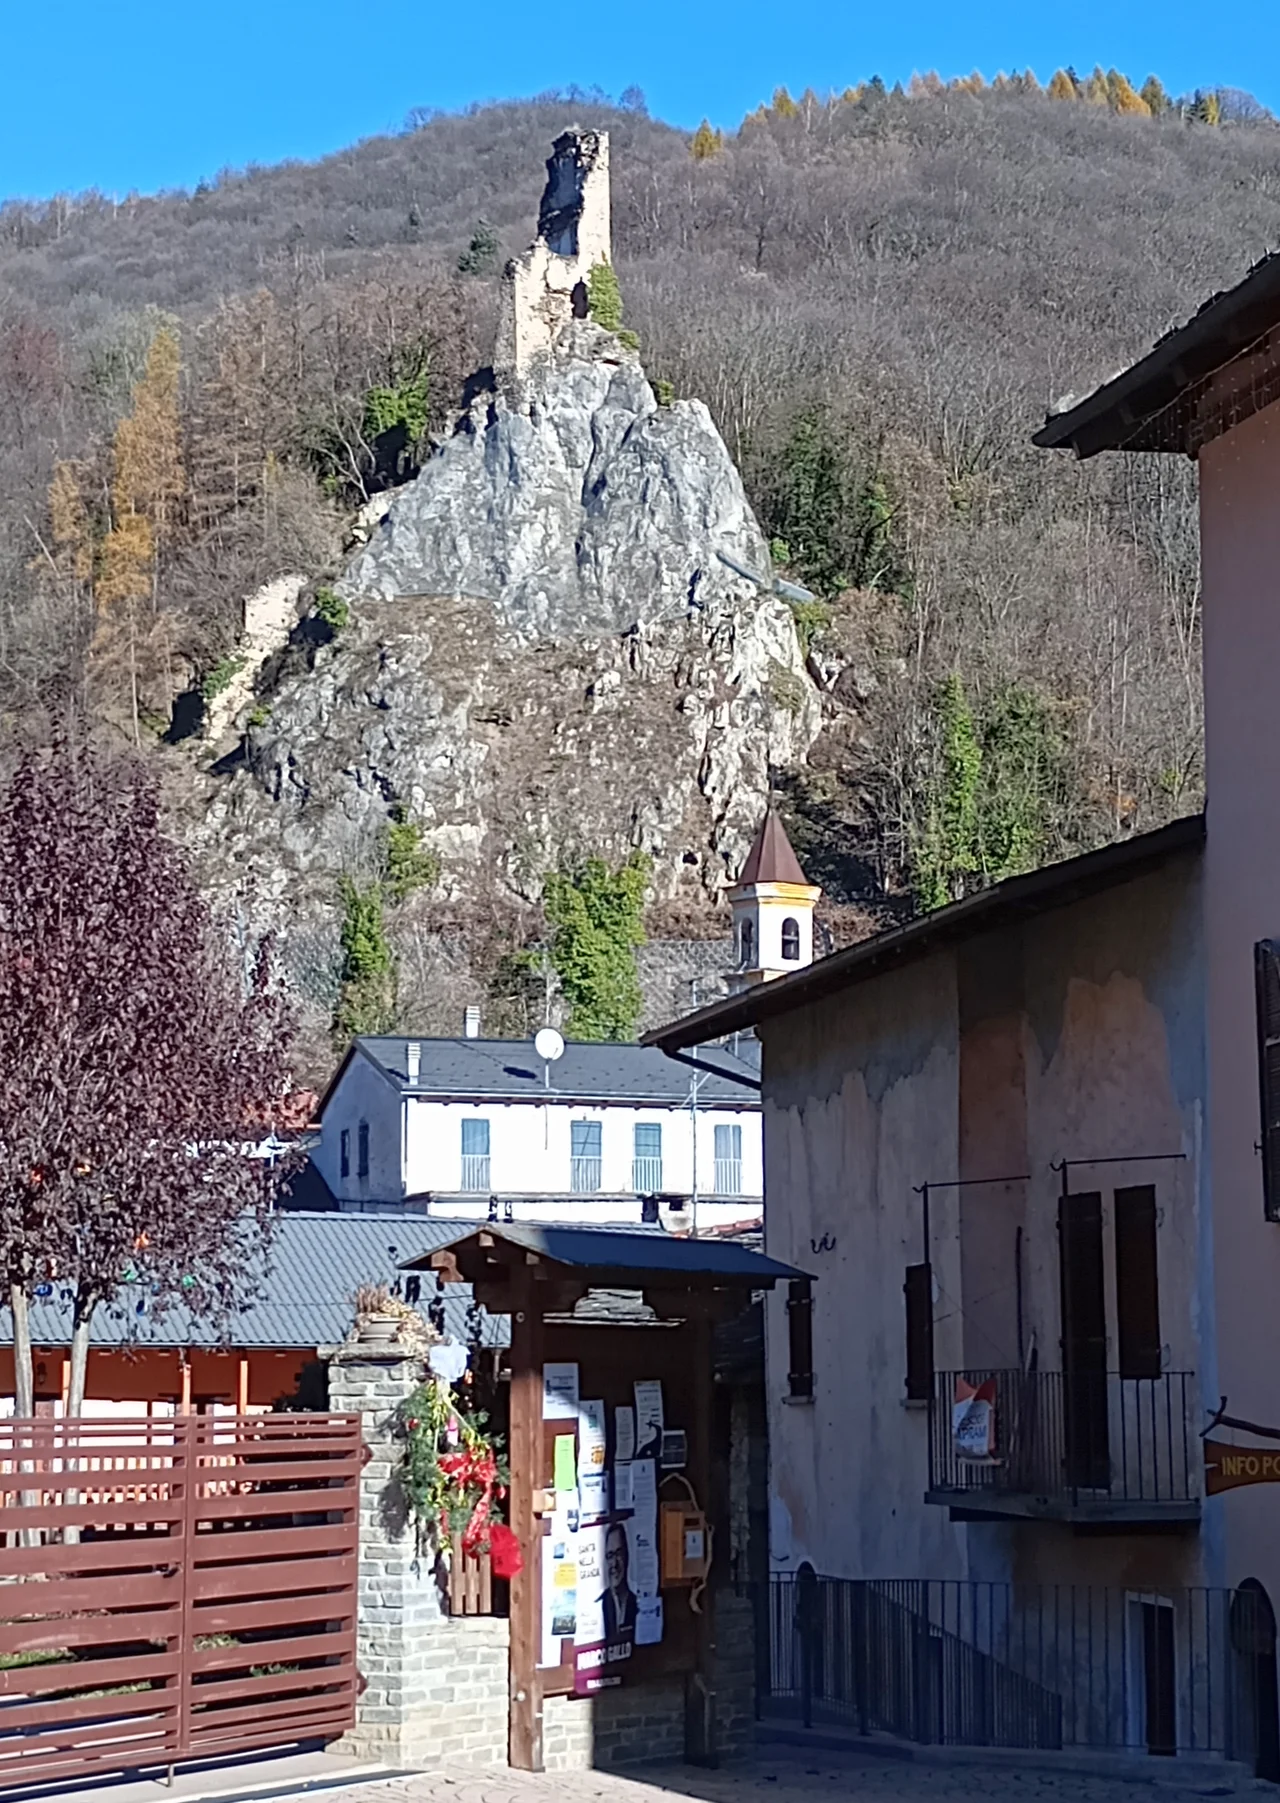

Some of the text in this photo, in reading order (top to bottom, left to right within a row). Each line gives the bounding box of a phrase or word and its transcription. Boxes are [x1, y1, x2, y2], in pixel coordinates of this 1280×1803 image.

[1221, 1456, 1259, 1476] INFO
[577, 1642, 632, 1670] MARCO GALLO
